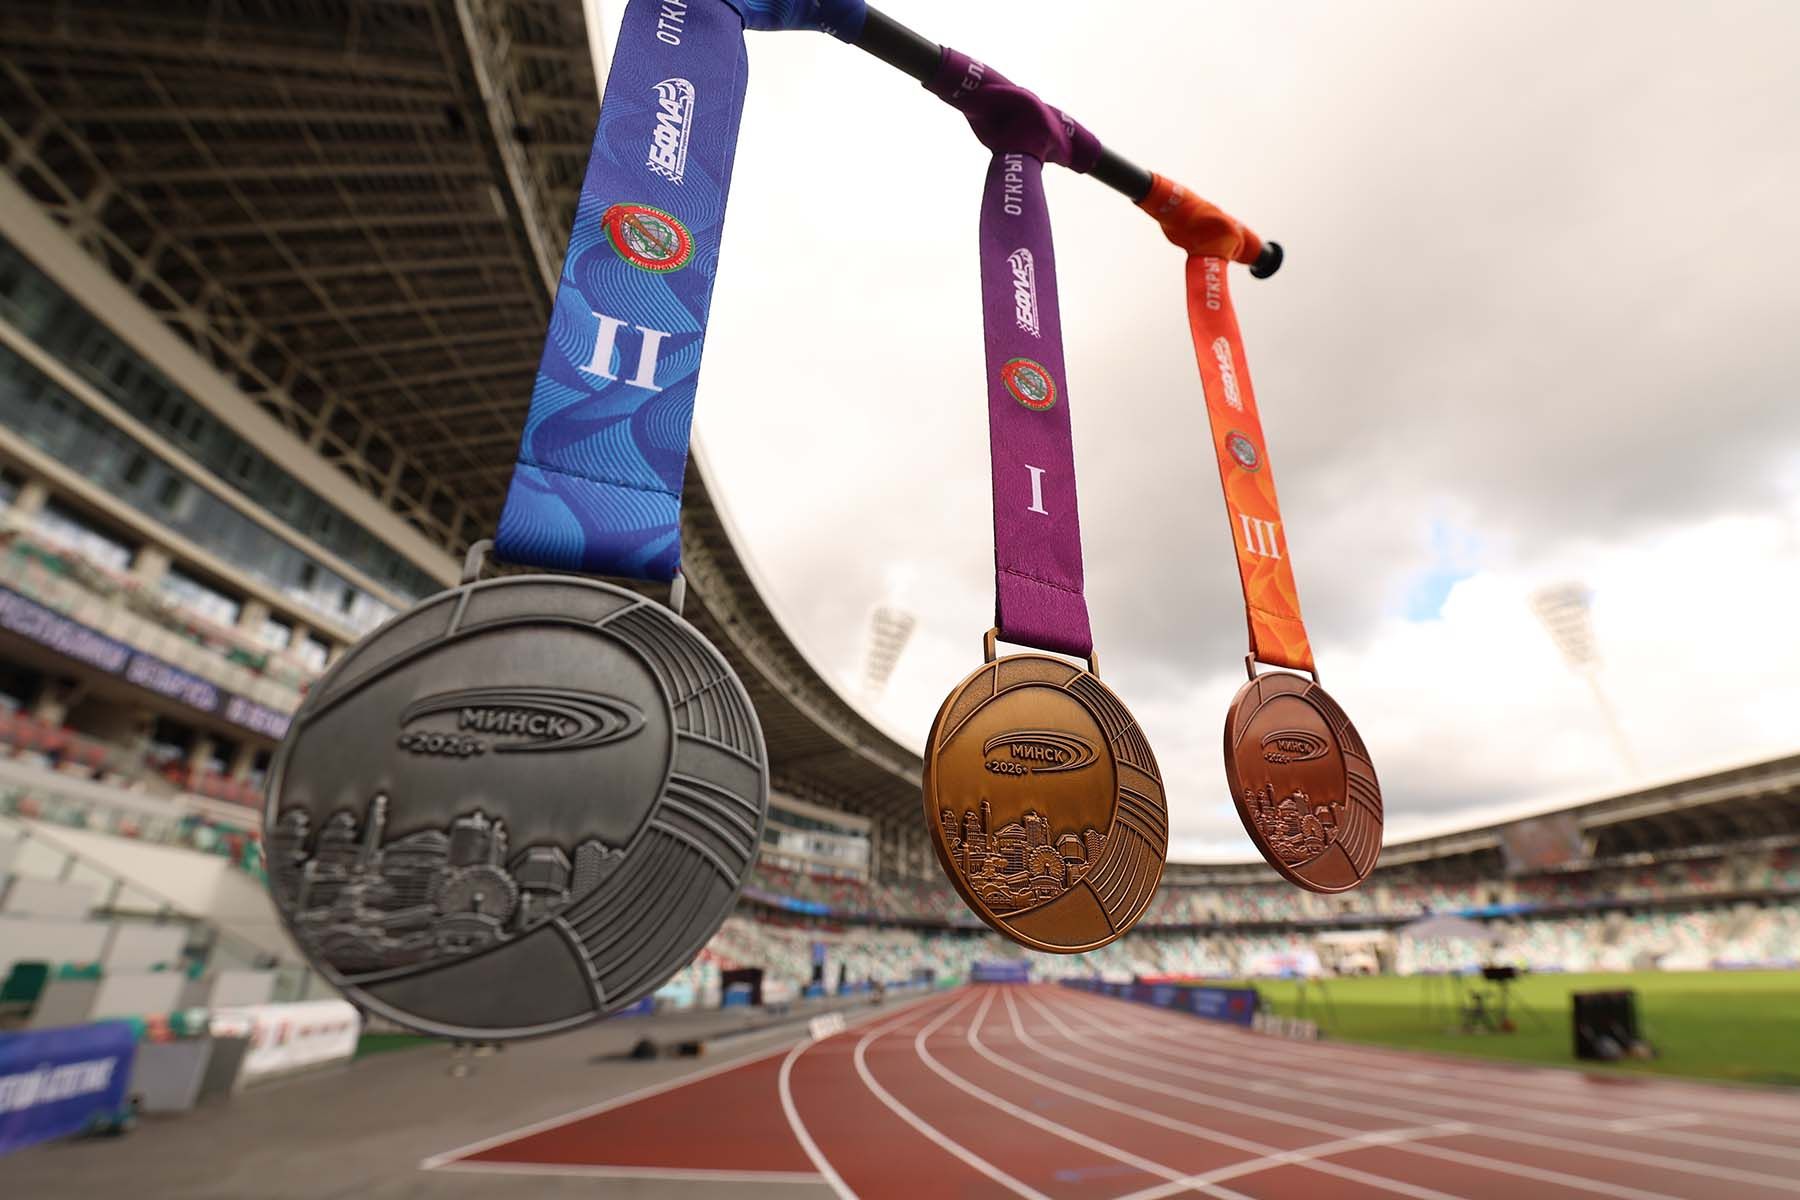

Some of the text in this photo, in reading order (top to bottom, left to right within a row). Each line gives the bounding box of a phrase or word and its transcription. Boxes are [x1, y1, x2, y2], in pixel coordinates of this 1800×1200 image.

[648, 96, 684, 173] БФЛА
[579, 311, 672, 392] II
[1024, 463, 1049, 516] I
[1238, 513, 1282, 560] III
[459, 707, 568, 738] МИНСК
[991, 760, 1023, 775] 2026
[1011, 743, 1064, 763] МИНСК
